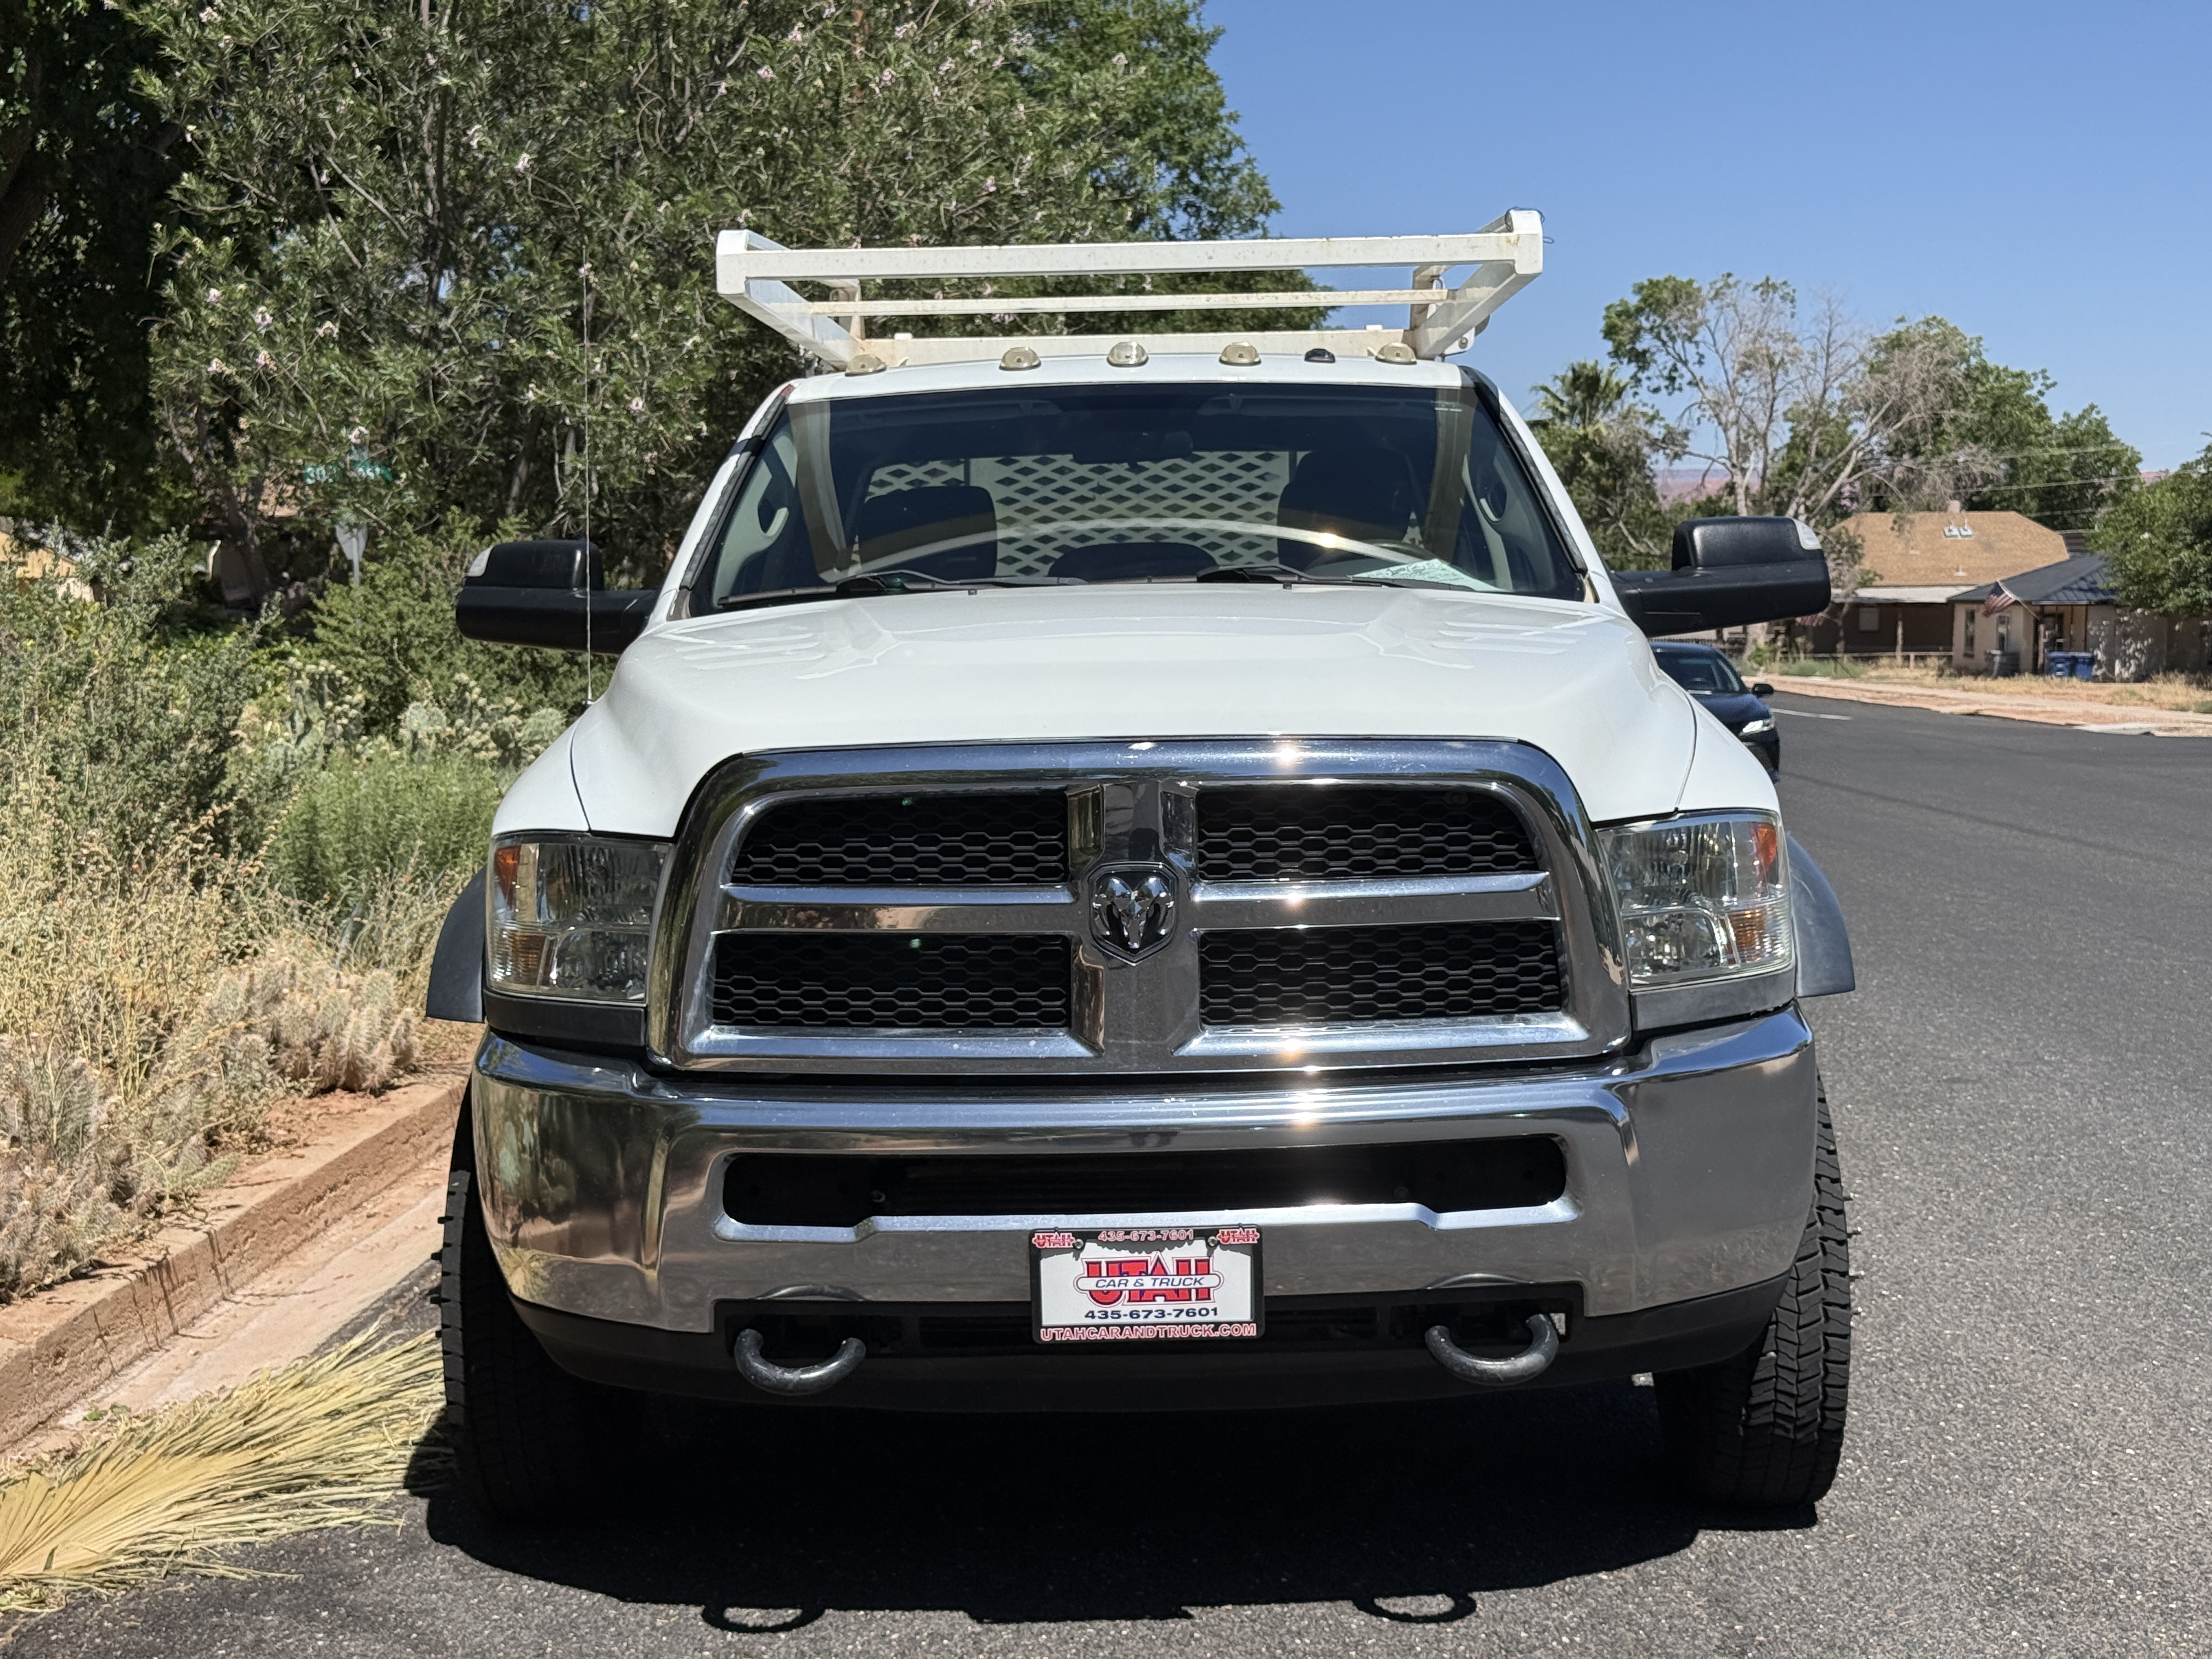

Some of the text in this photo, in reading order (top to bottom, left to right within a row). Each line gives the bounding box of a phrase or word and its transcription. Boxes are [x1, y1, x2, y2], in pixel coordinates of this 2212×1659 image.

[1035, 1233, 1073, 1248] UTAH
[1098, 1229, 1194, 1242] 435-673-7601
[1220, 1228, 1257, 1244] UTAH
[1085, 1256, 1211, 1305] UTAH
[1096, 1277, 1205, 1288] CAR & TRUCK
[1084, 1307, 1218, 1320] 435-673-7601
[1040, 1323, 1257, 1341] UTAHCARANDTRUCK.COM
